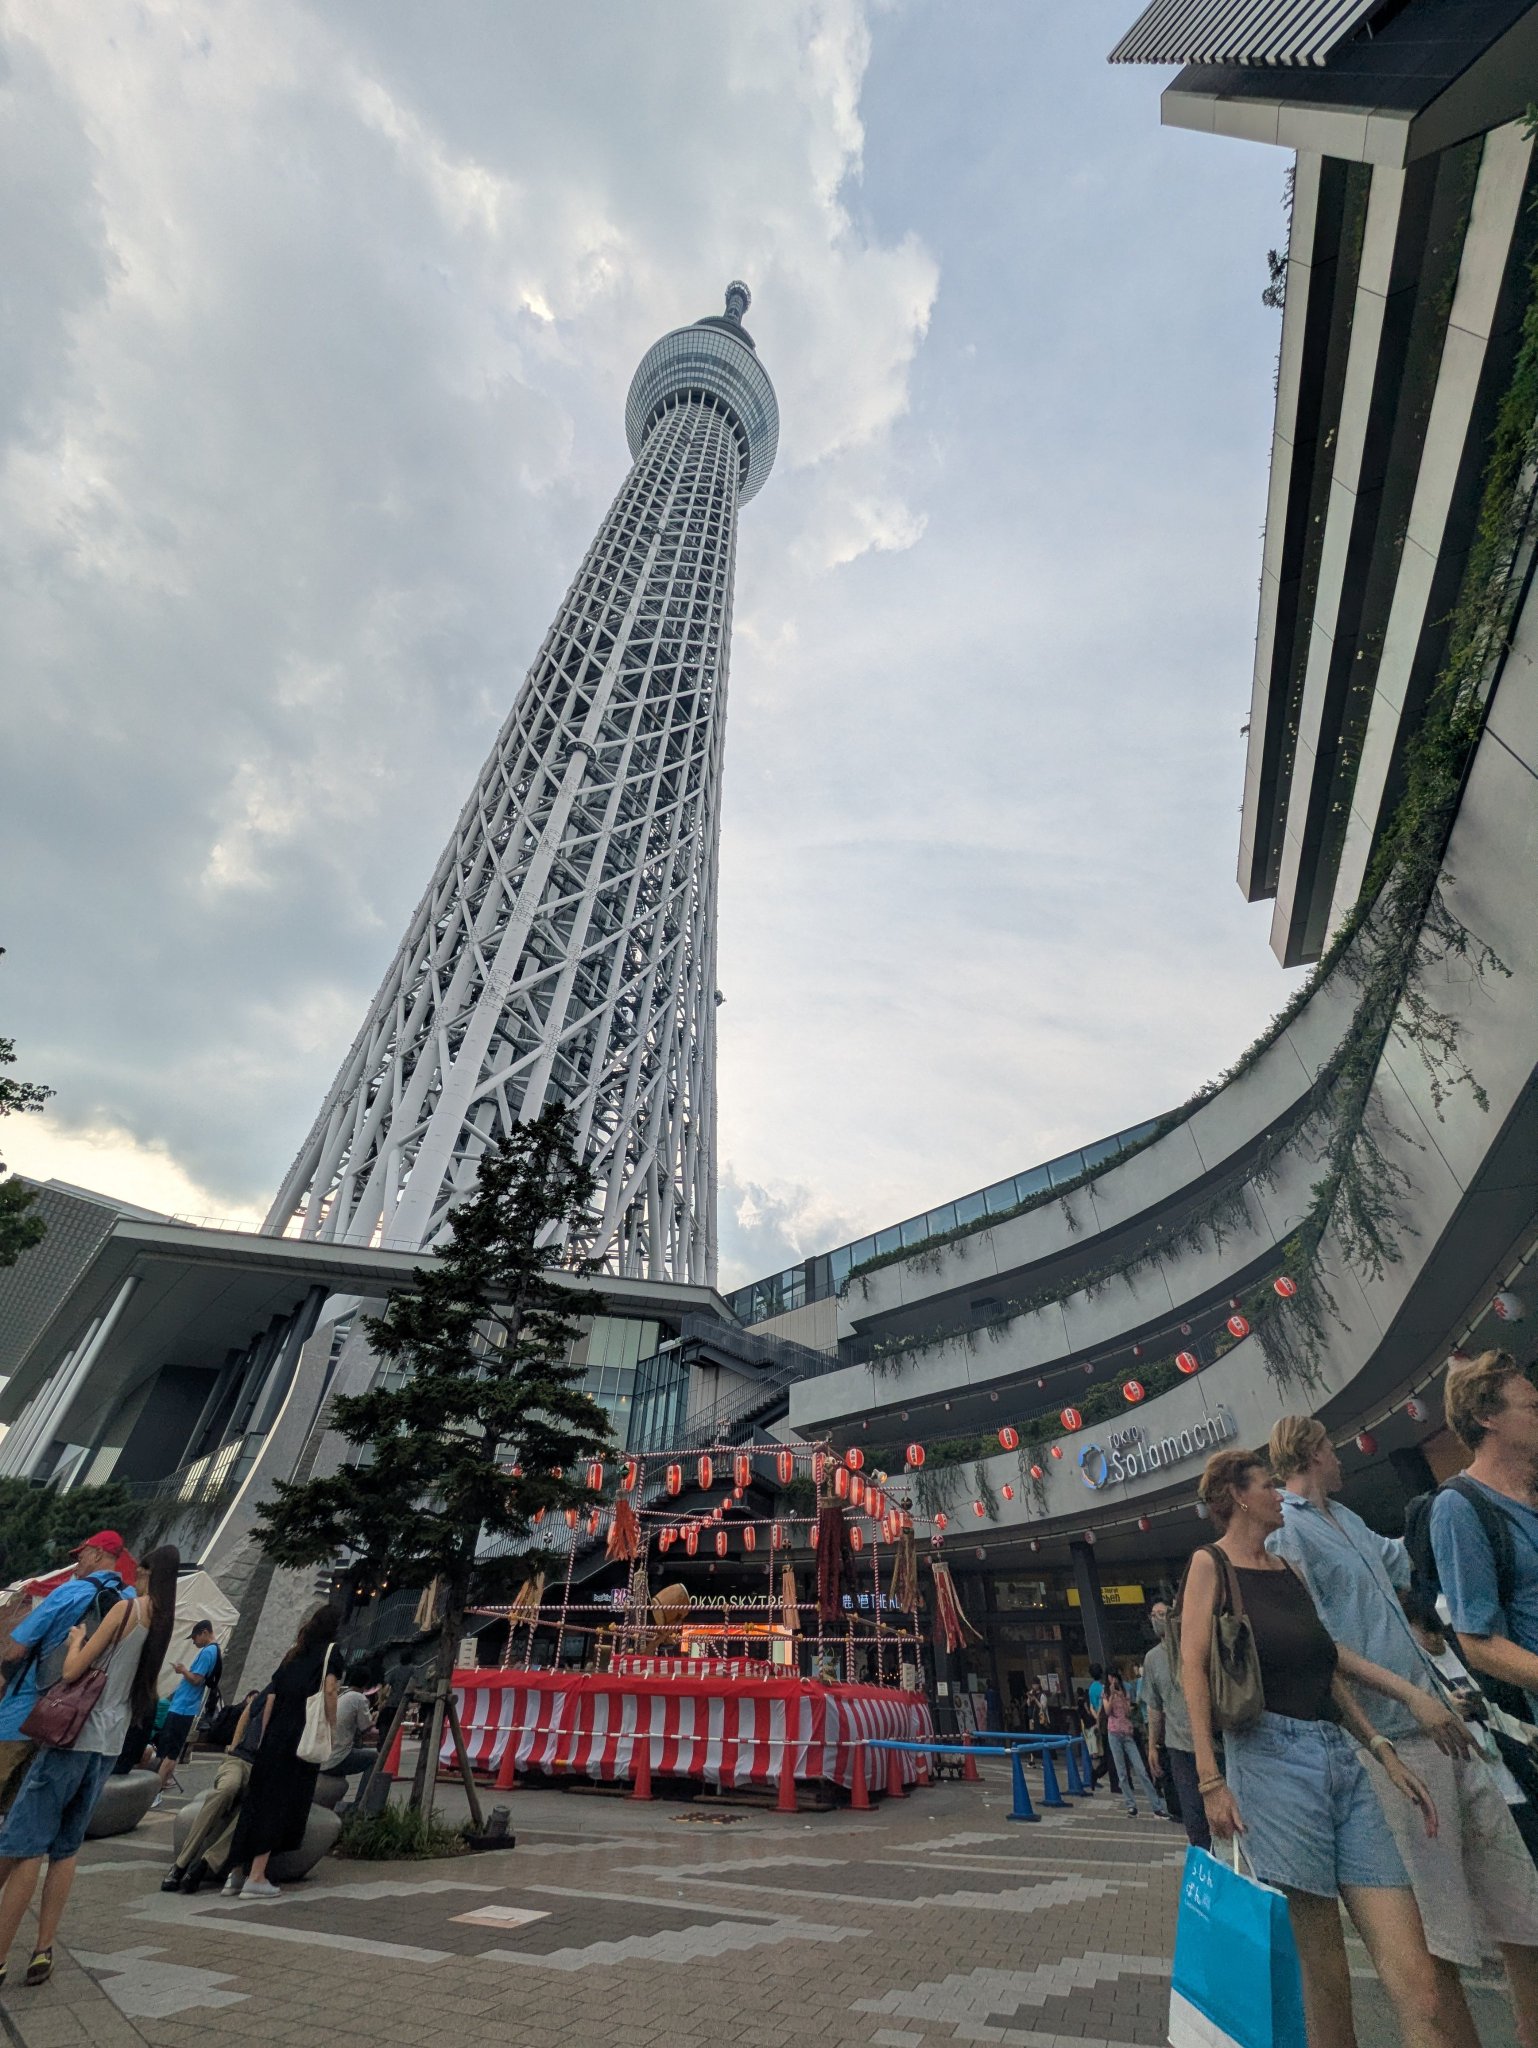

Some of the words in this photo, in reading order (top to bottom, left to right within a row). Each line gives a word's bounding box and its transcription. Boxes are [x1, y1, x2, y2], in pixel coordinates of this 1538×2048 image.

[1107, 1425, 1139, 1449] TOKYO
[1111, 1403, 1228, 1481] Solamachi
[689, 1595, 726, 1607] OKYO
[730, 1595, 797, 1607] SKYTRE
